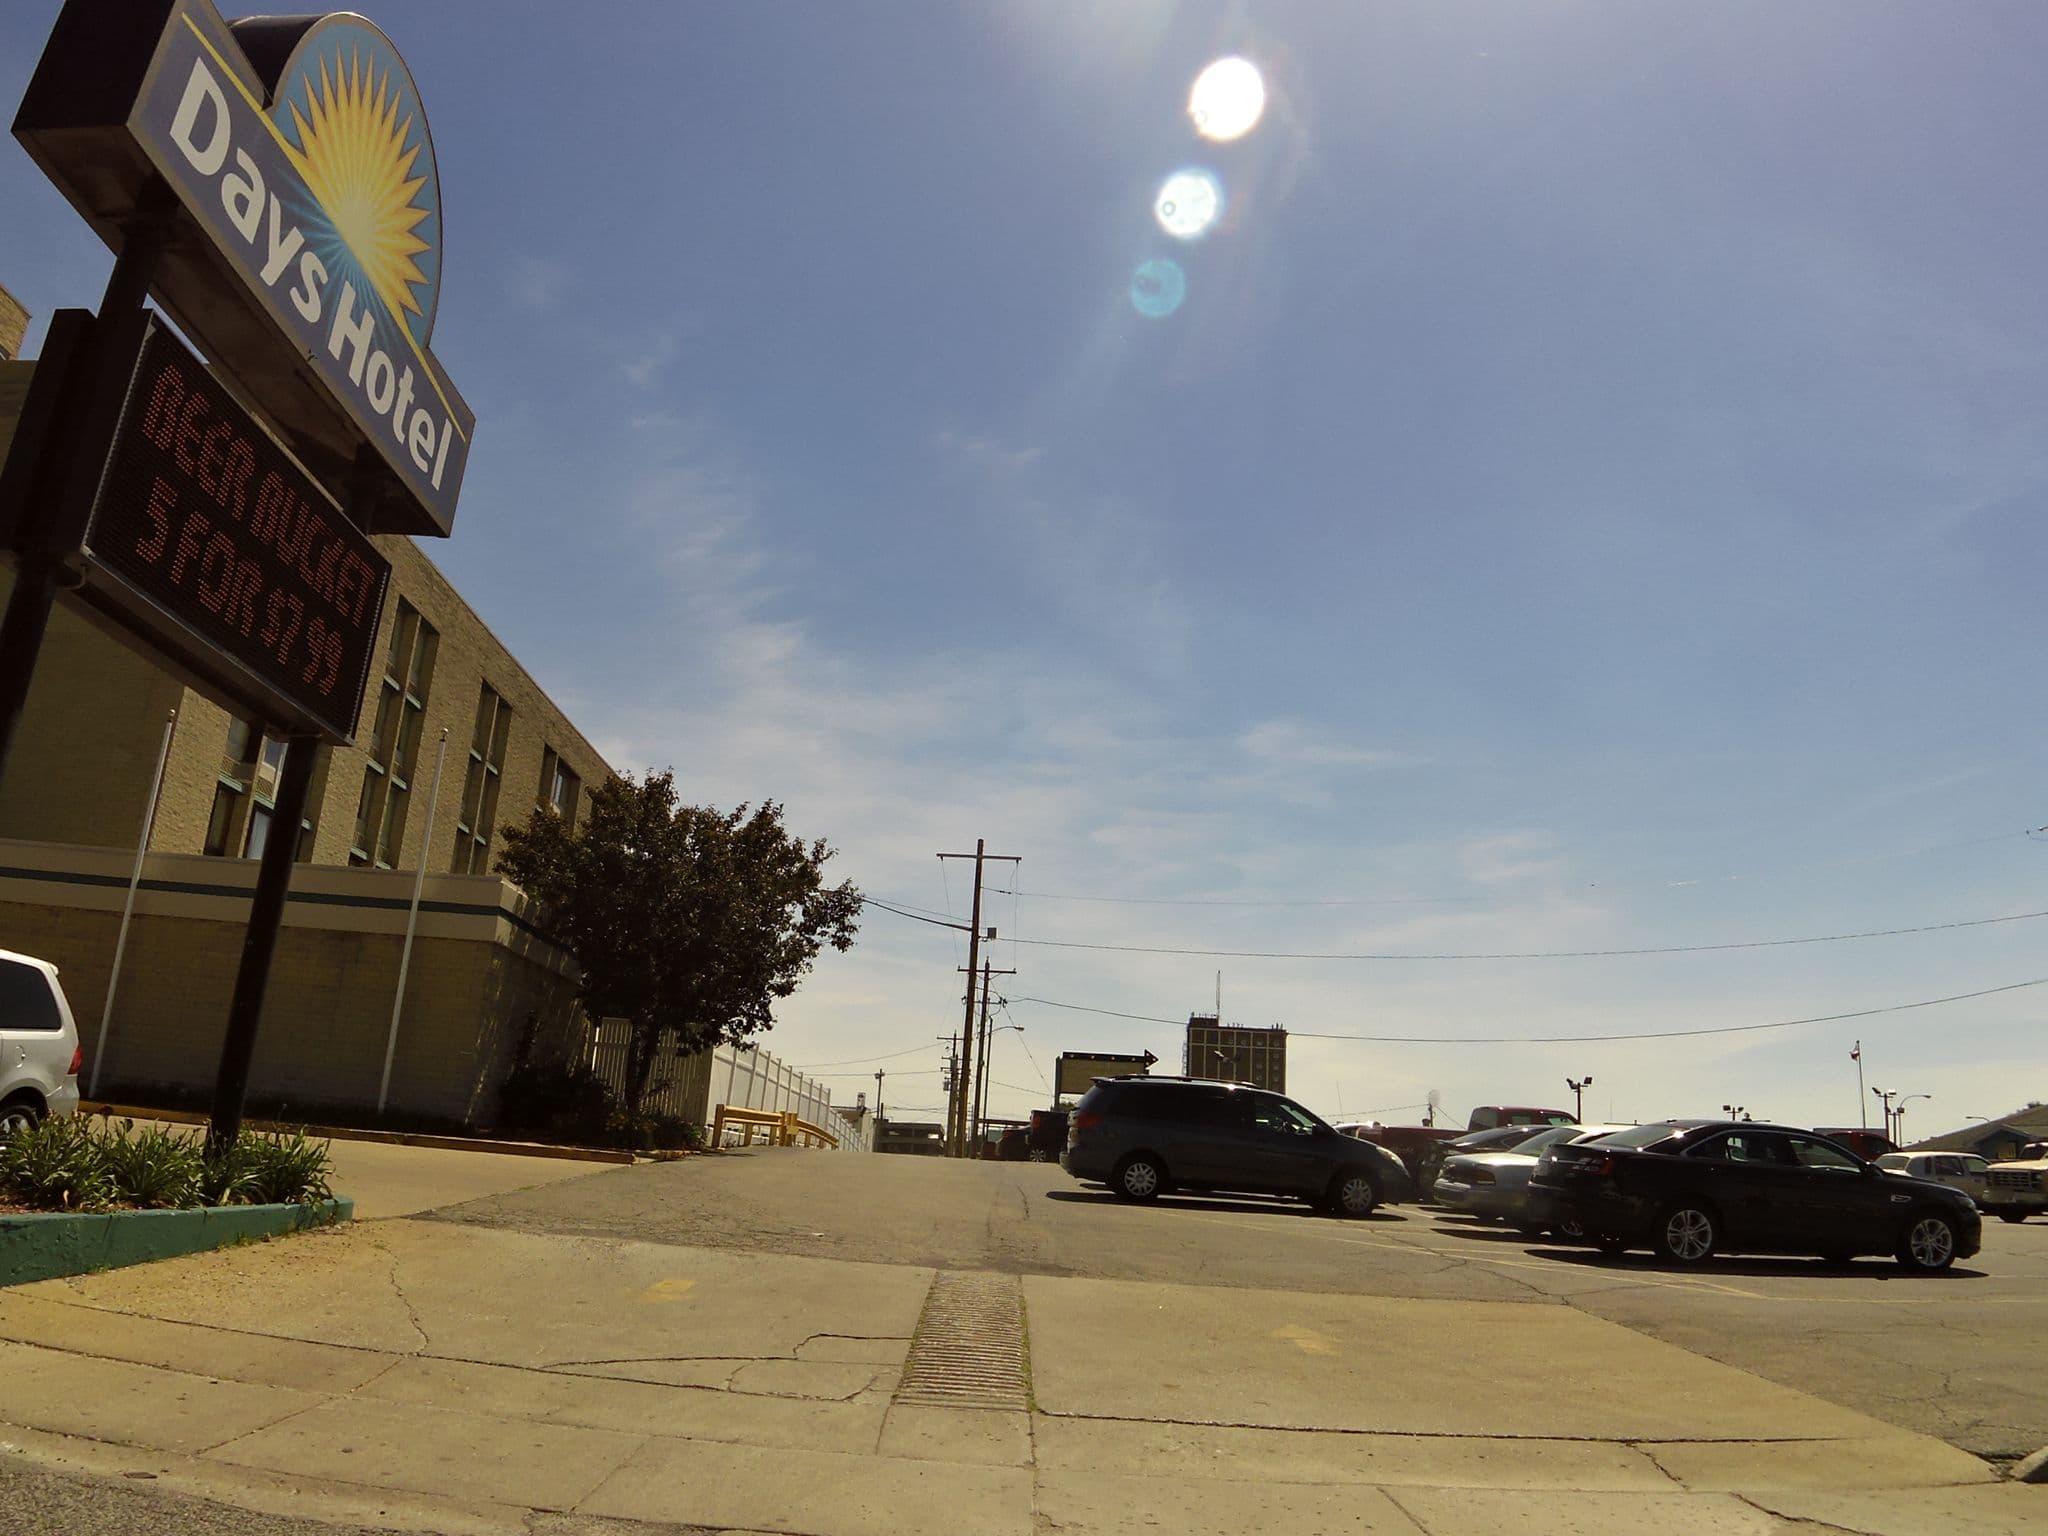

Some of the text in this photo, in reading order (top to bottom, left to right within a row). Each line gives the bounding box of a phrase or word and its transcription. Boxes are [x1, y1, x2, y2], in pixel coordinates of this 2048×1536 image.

[169, 56, 453, 492] Days Hotel
[136, 476, 178, 563] 5
[169, 510, 263, 638] FOR
[142, 364, 376, 629] BEER BUCKET
